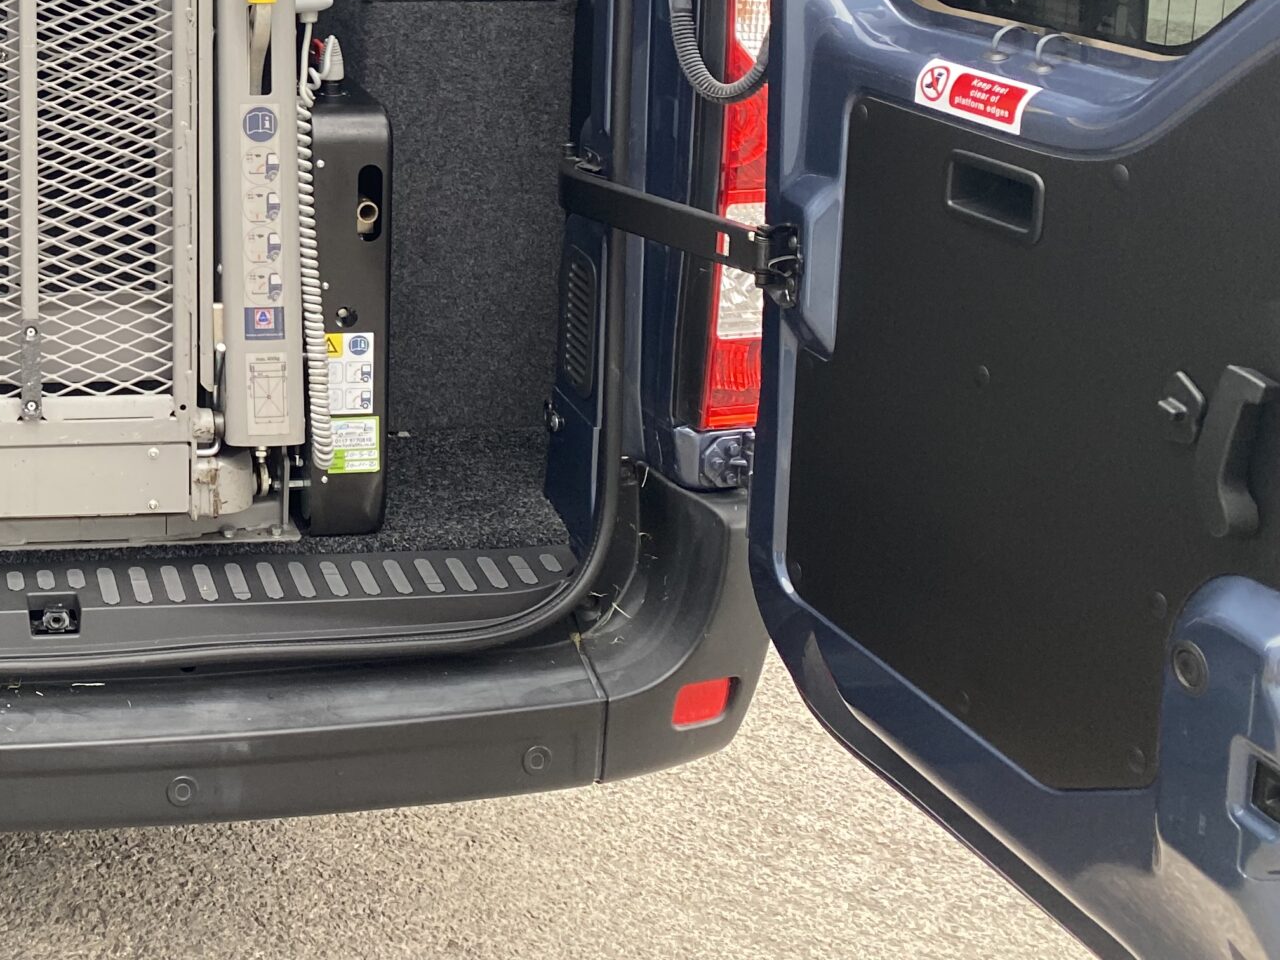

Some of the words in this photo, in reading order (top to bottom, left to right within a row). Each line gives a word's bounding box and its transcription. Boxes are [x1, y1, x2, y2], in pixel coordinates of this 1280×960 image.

[971, 78, 992, 93] Keep
[991, 83, 1010, 95] feet
[969, 89, 989, 100] clear
[990, 95, 1000, 103] of
[954, 95, 985, 111] platform
[986, 105, 1009, 118] edges
